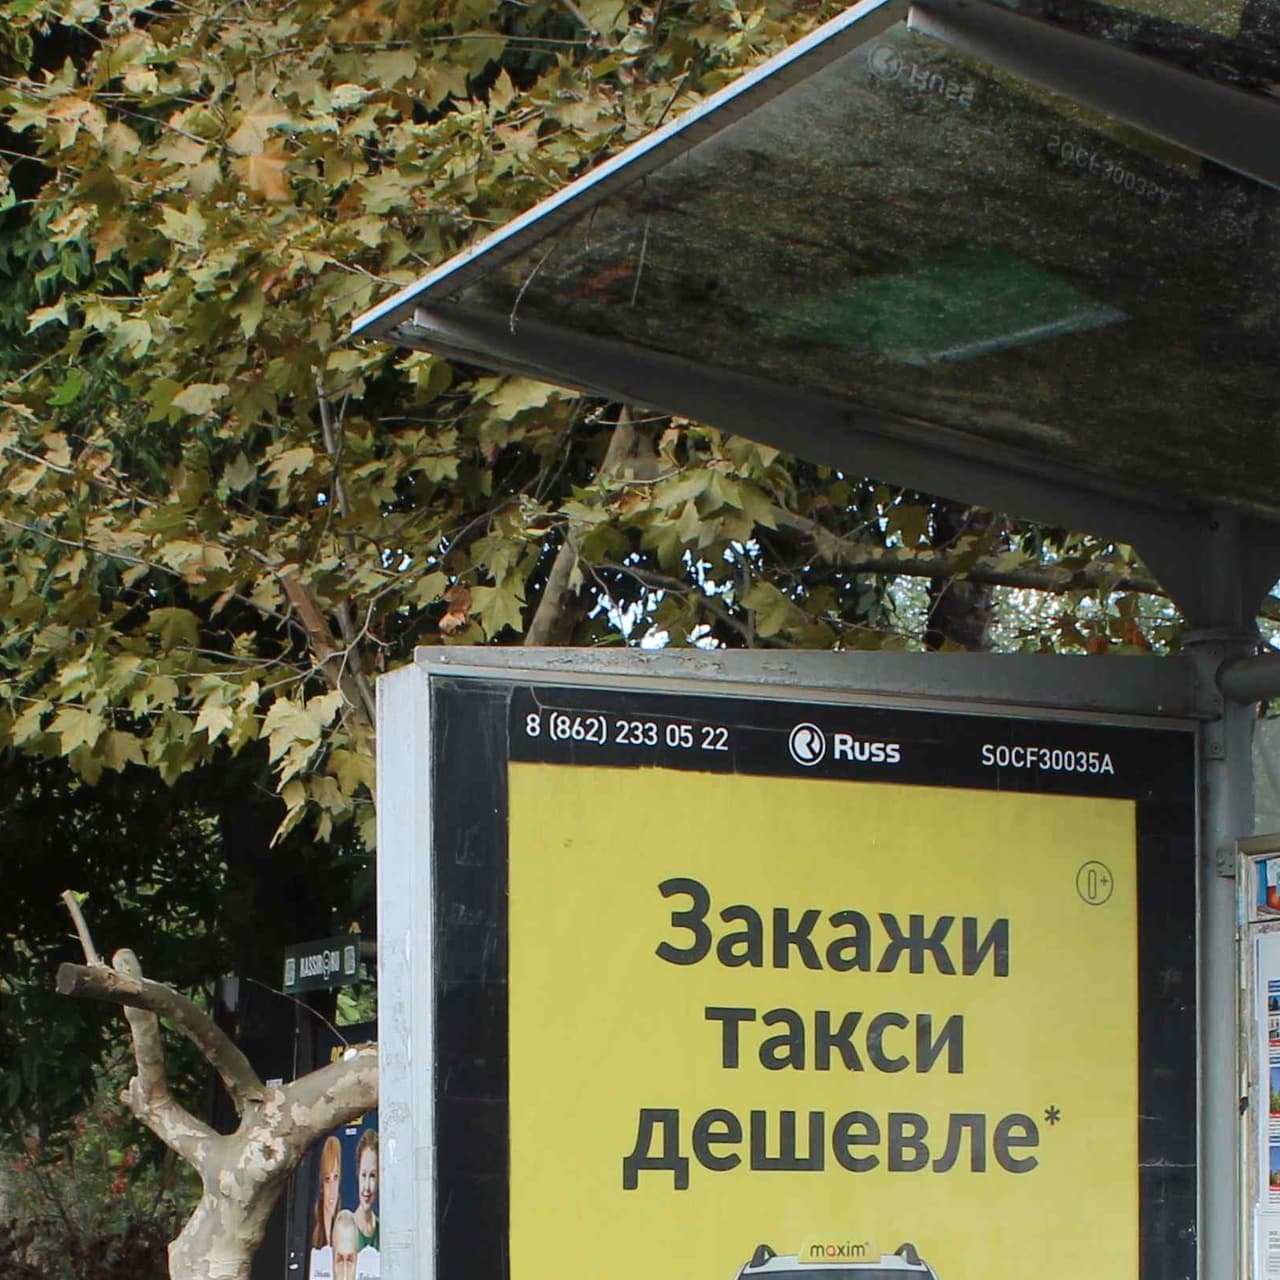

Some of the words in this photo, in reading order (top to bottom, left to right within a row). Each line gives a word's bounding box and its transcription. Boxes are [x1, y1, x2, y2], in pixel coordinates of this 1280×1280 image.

[525, 713, 541, 737] 8
[549, 711, 608, 745] (862)
[615, 719, 658, 747] 233
[665, 723, 694, 749] 05
[701, 726, 729, 751] 22
[833, 733, 901, 763] Russ
[981, 744, 1116, 775] SOCF30035A
[654, 876, 1012, 978] Закажи
[704, 1005, 966, 1075] такси
